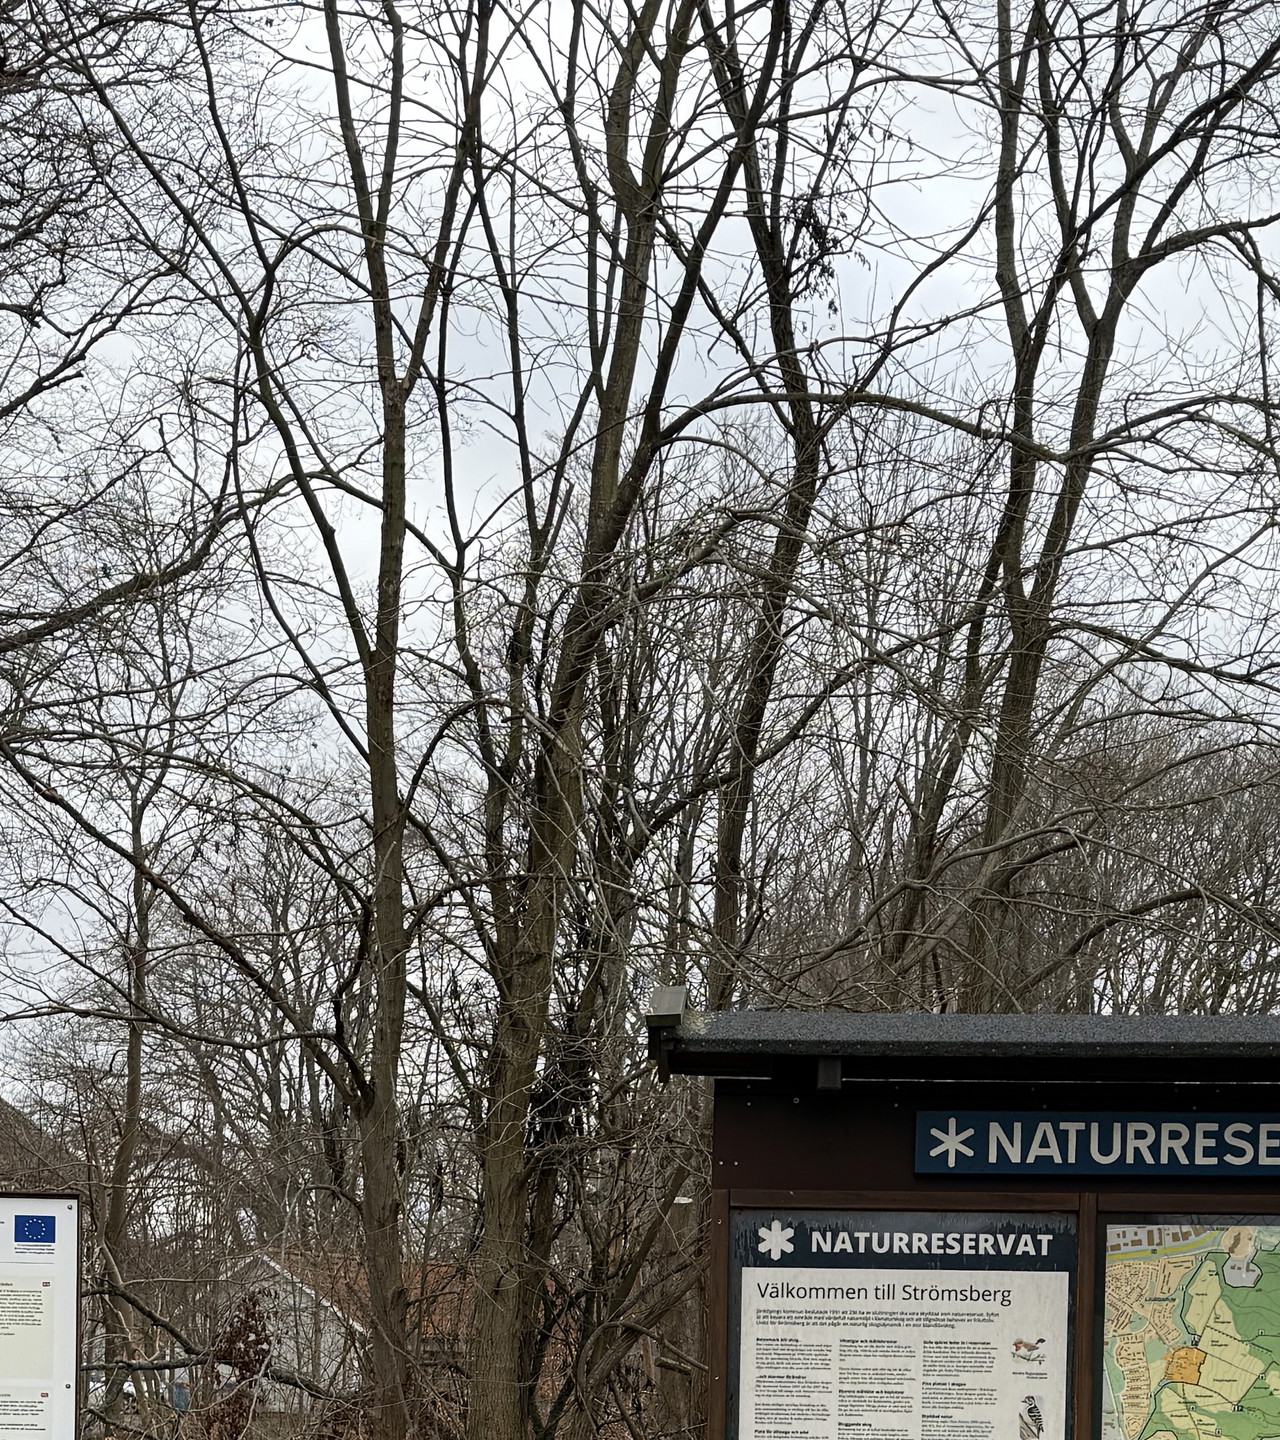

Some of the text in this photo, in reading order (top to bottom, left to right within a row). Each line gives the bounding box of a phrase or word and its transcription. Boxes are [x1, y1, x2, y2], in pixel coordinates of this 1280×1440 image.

[812, 1231, 1053, 1255] NATURRESERVAT
[757, 1282, 1011, 1306] Välkommen till Strömsberg
